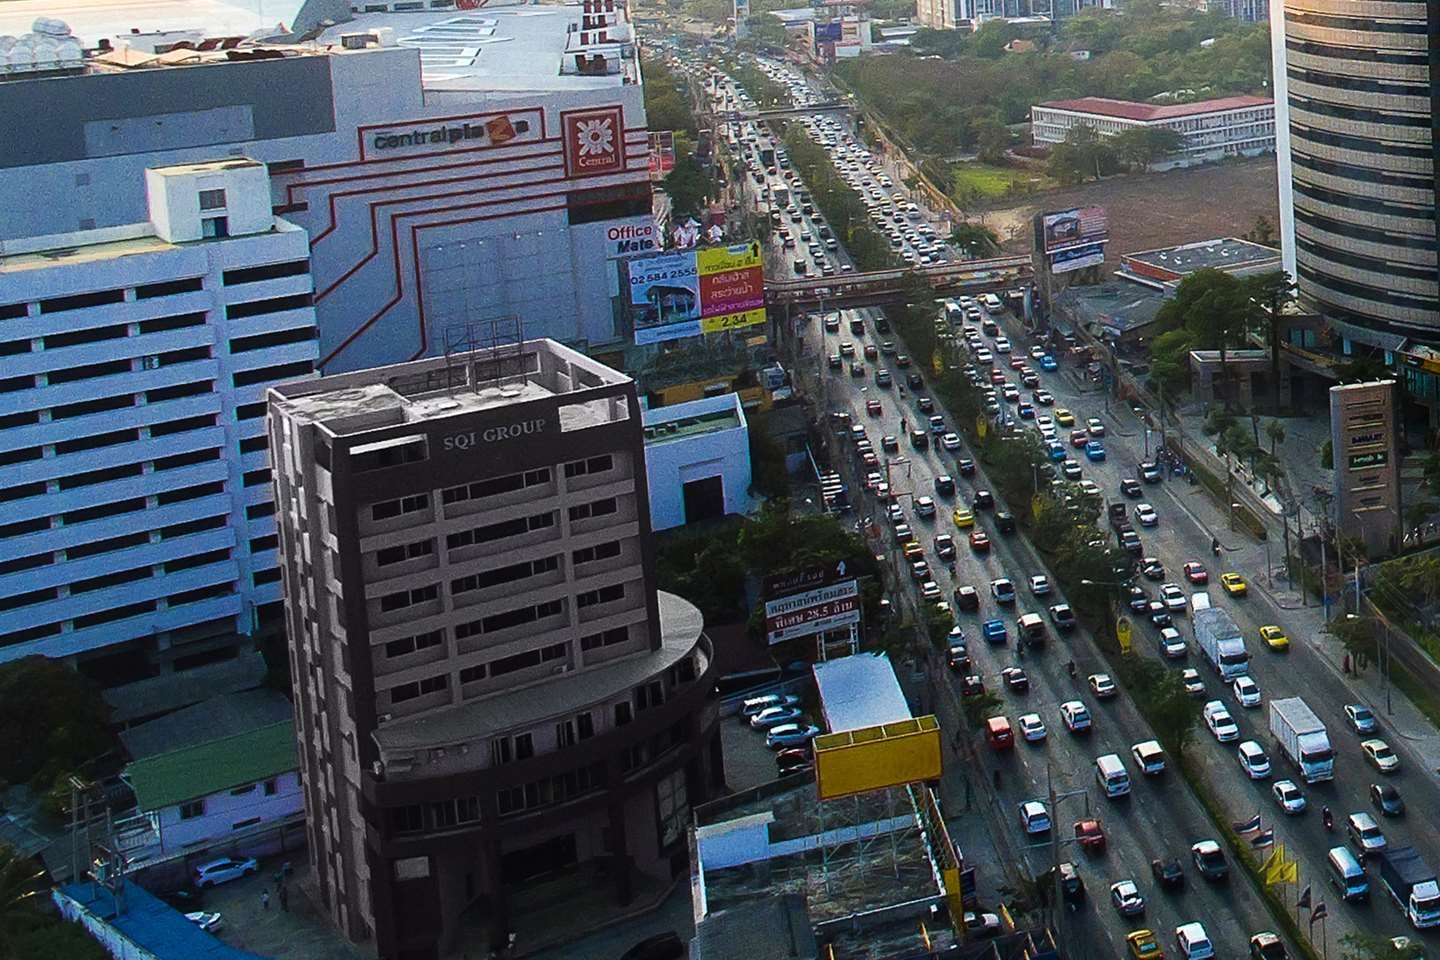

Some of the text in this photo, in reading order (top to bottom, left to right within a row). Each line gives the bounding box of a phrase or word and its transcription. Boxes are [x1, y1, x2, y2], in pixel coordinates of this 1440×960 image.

[578, 155, 616, 167] Central
[608, 226, 652, 240] Office
[618, 239, 653, 253] Mate
[631, 276, 645, 285] 02
[444, 419, 545, 450] SQI GROUP
[807, 605, 829, 621] 28.5
